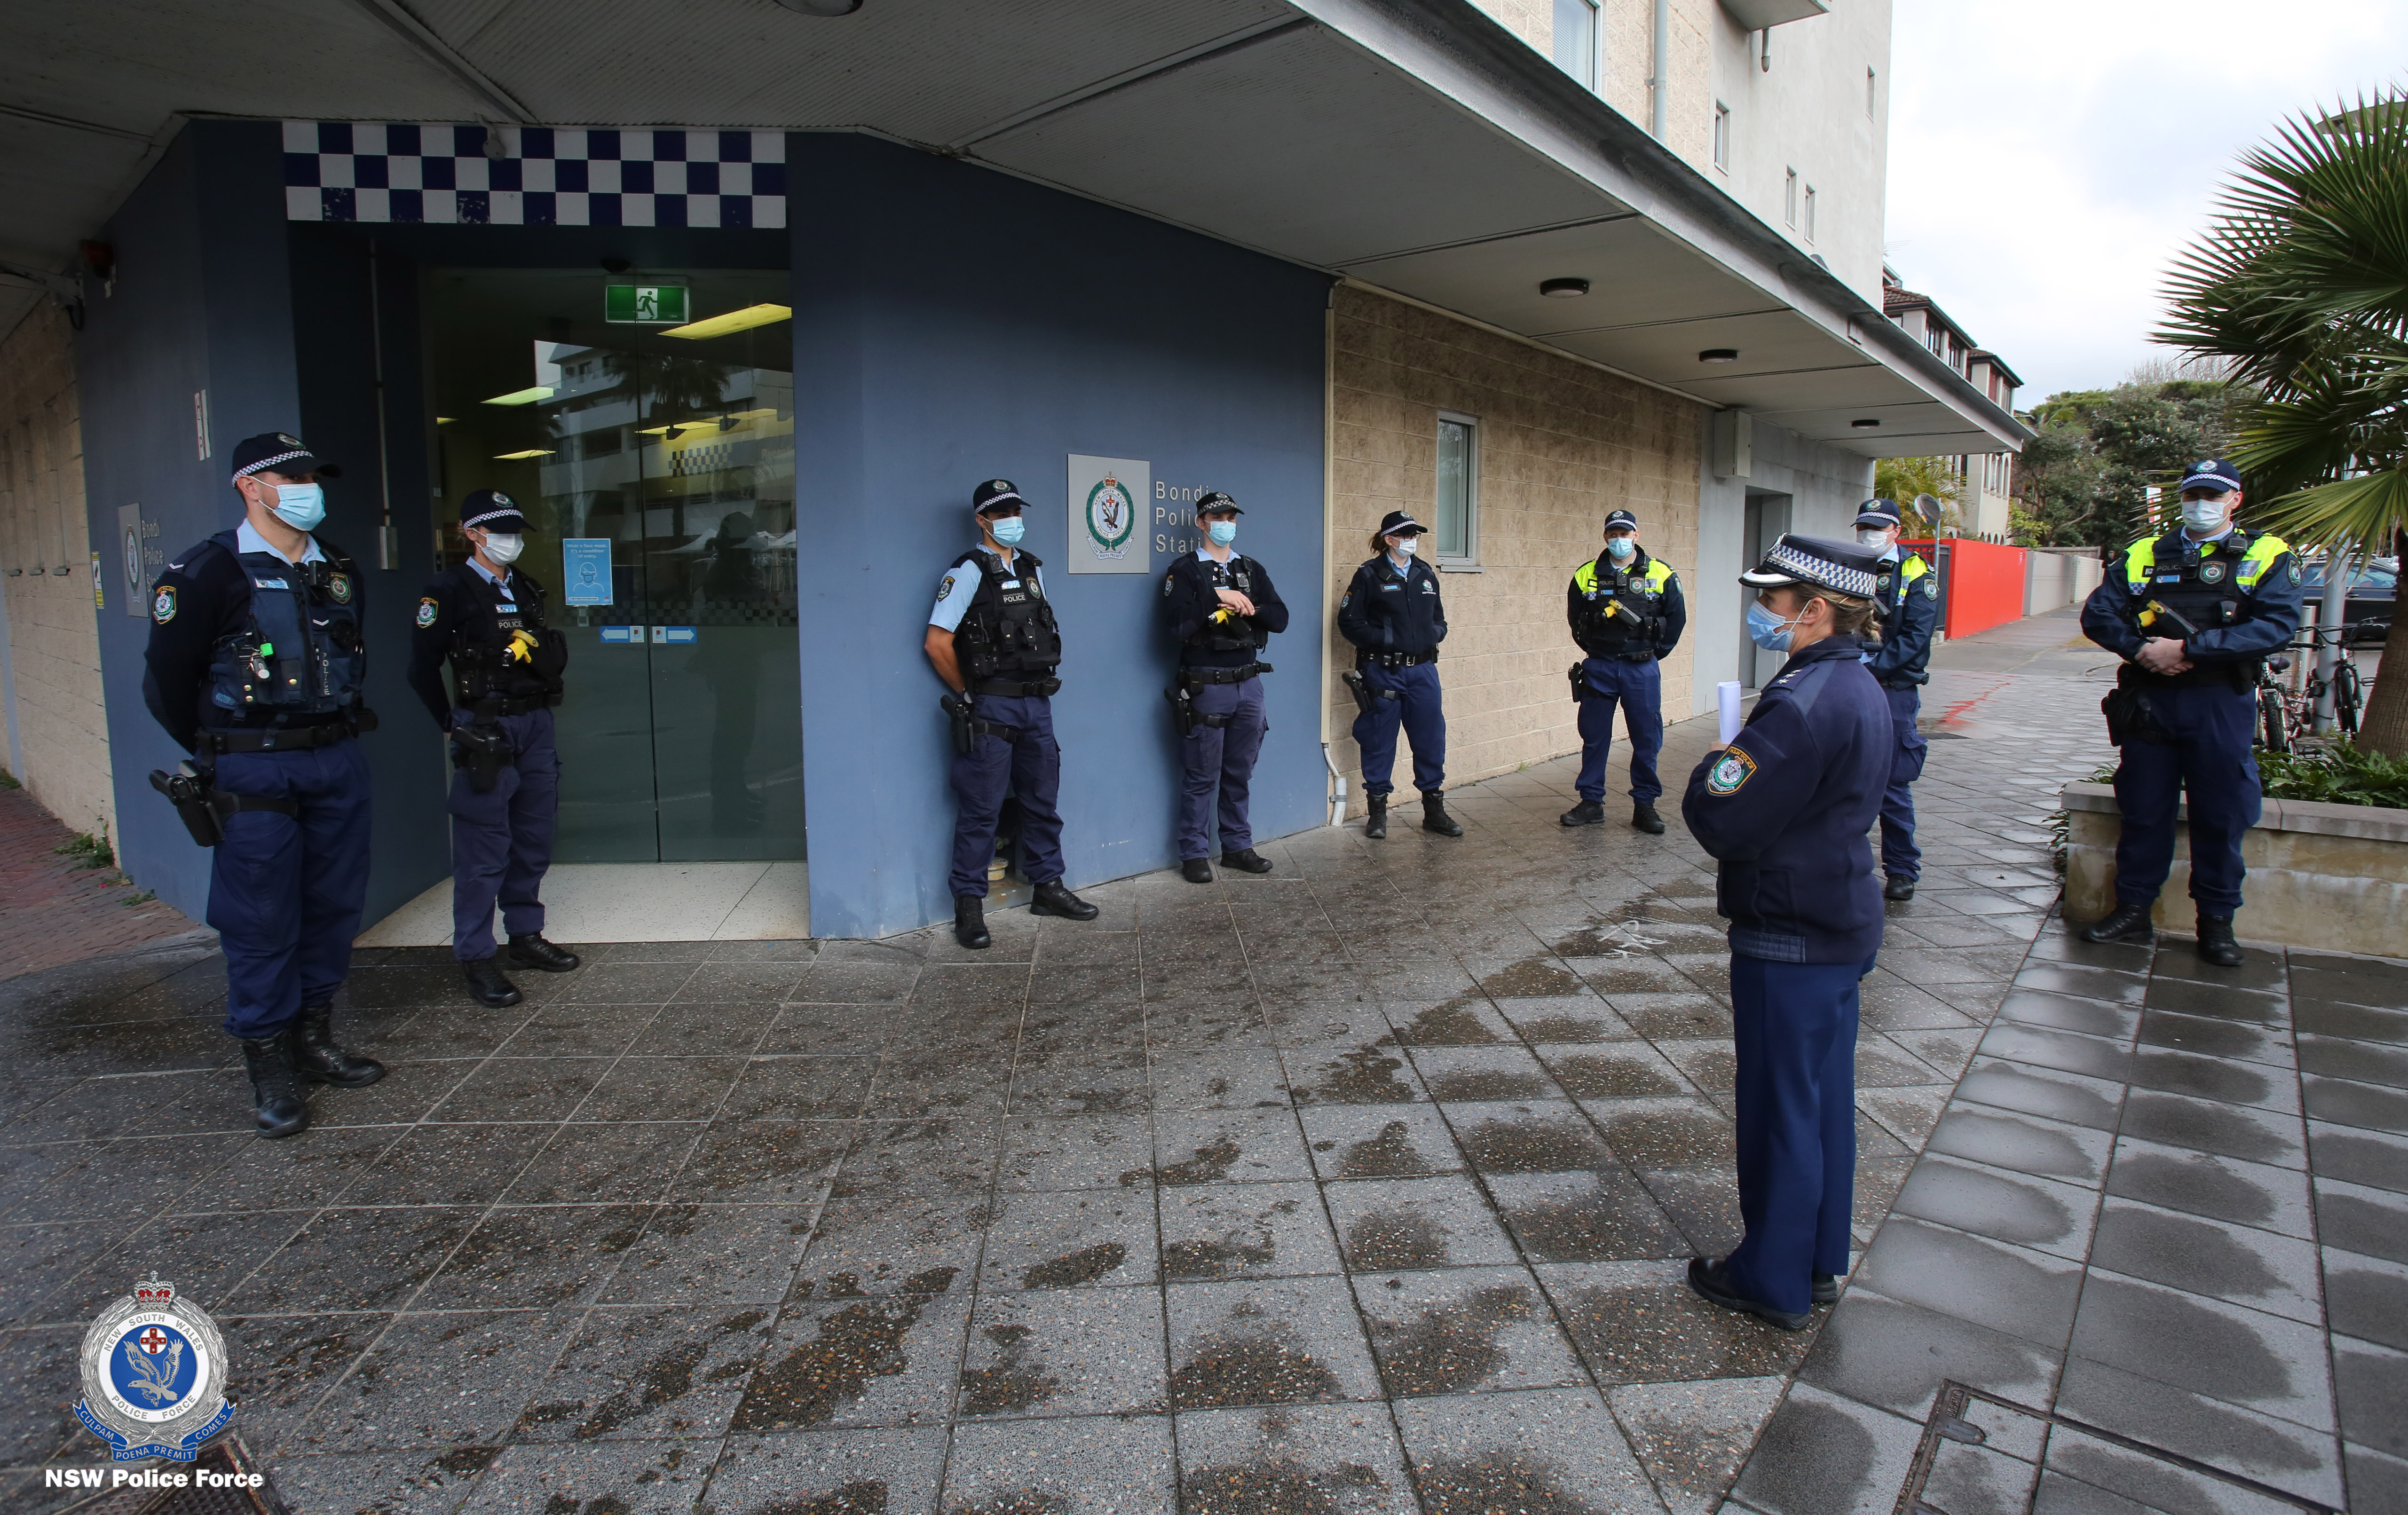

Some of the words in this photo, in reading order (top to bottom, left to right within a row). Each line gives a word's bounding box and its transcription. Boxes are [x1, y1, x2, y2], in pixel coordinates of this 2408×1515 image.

[1117, 493, 1126, 507] WALES
[1155, 481, 1209, 502] Bondi
[1156, 507, 1200, 527] Polic
[142, 518, 160, 539] Bondi
[1097, 526, 1109, 537] POLICE
[1113, 527, 1124, 537] FORCE
[1156, 534, 1201, 553] Stati
[144, 546, 164, 565] Police
[1740, 754, 1754, 769] POLICE
